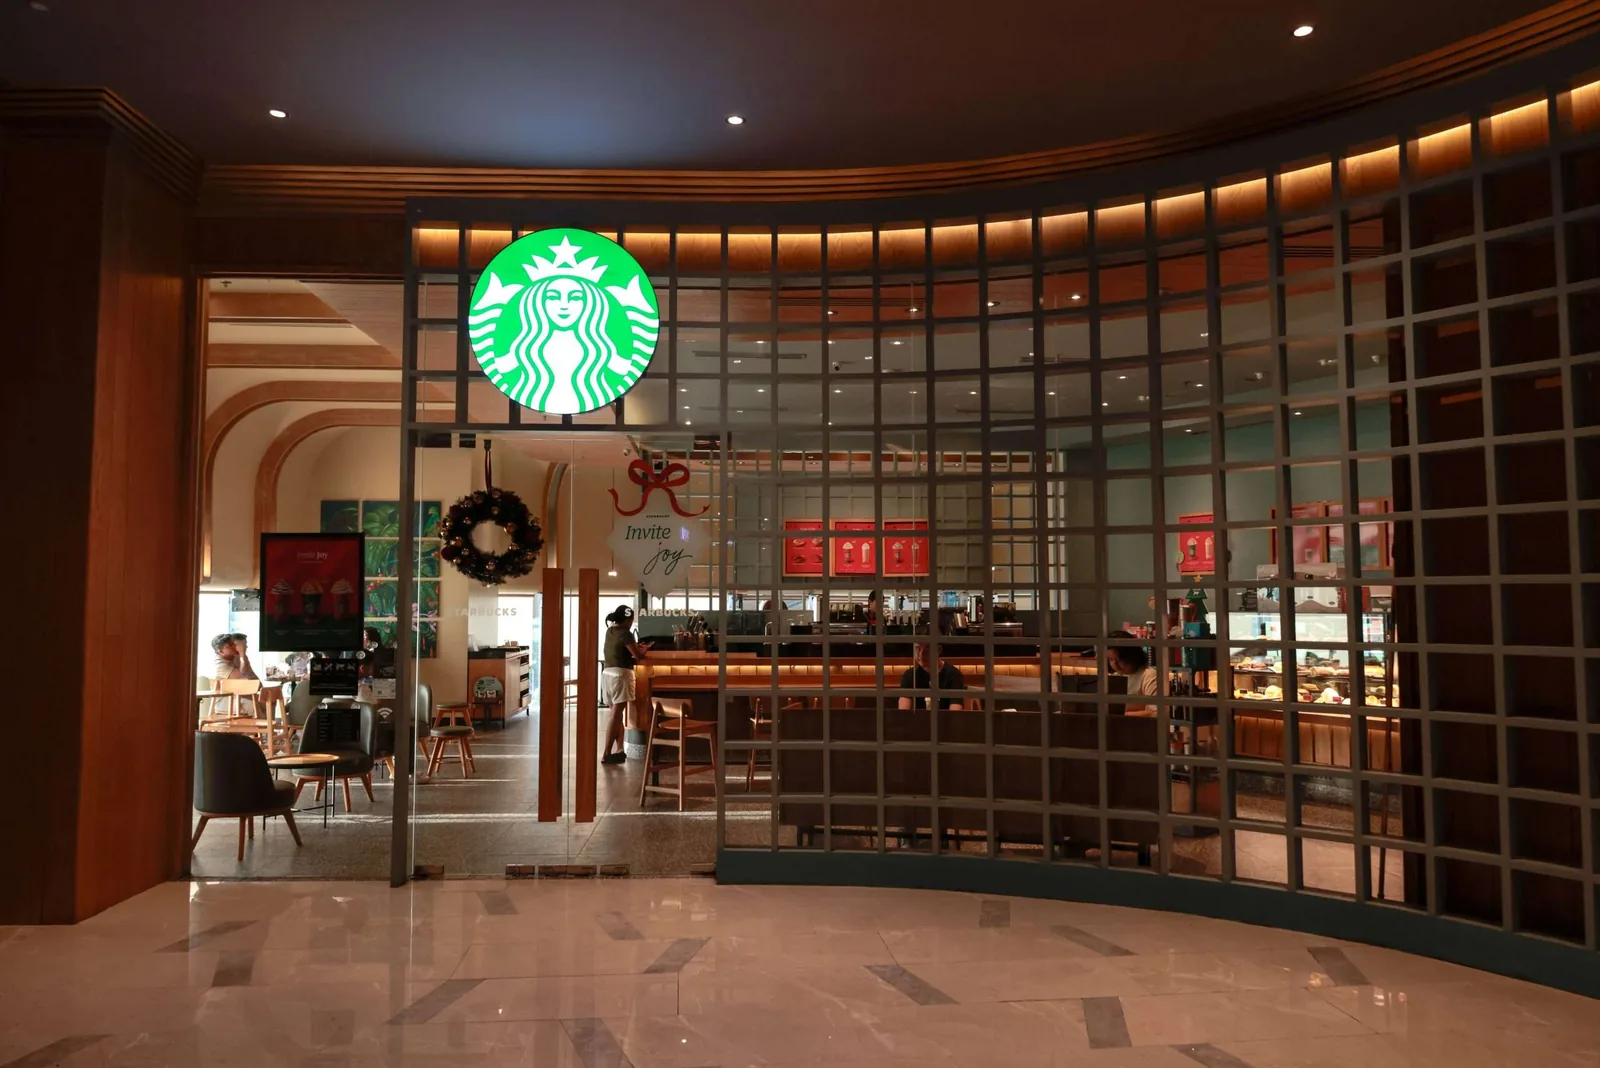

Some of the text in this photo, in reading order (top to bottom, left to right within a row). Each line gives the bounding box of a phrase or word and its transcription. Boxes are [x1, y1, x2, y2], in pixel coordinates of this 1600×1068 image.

[625, 524, 671, 540] Invite
[643, 542, 692, 576] joy
[449, 607, 517, 617] TARBUCKS
